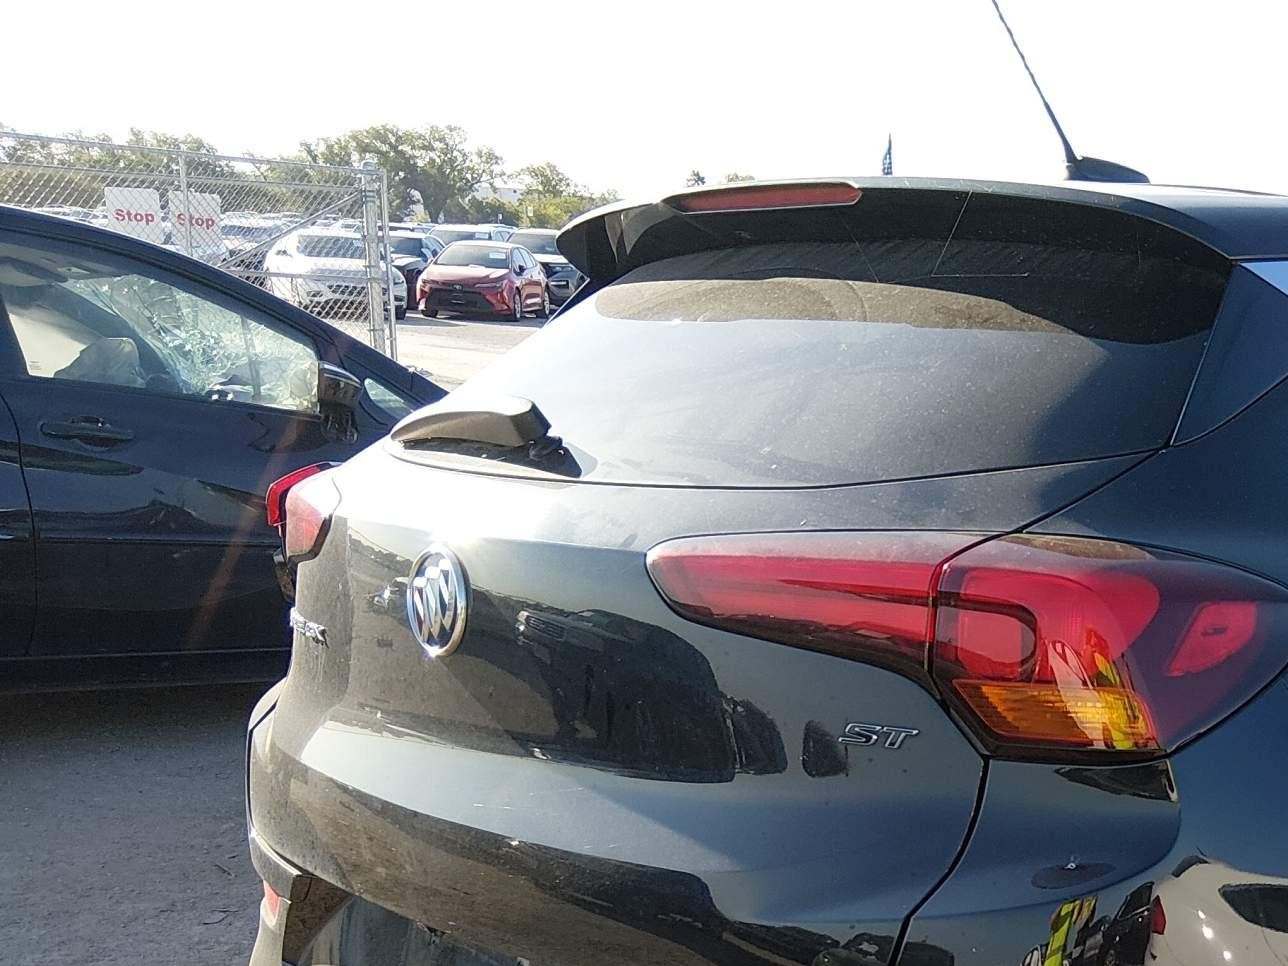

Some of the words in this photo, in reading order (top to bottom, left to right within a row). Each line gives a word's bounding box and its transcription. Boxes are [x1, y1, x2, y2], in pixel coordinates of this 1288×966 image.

[114, 208, 155, 225] Stop
[176, 212, 215, 230] Stop
[838, 722, 920, 749] ST
